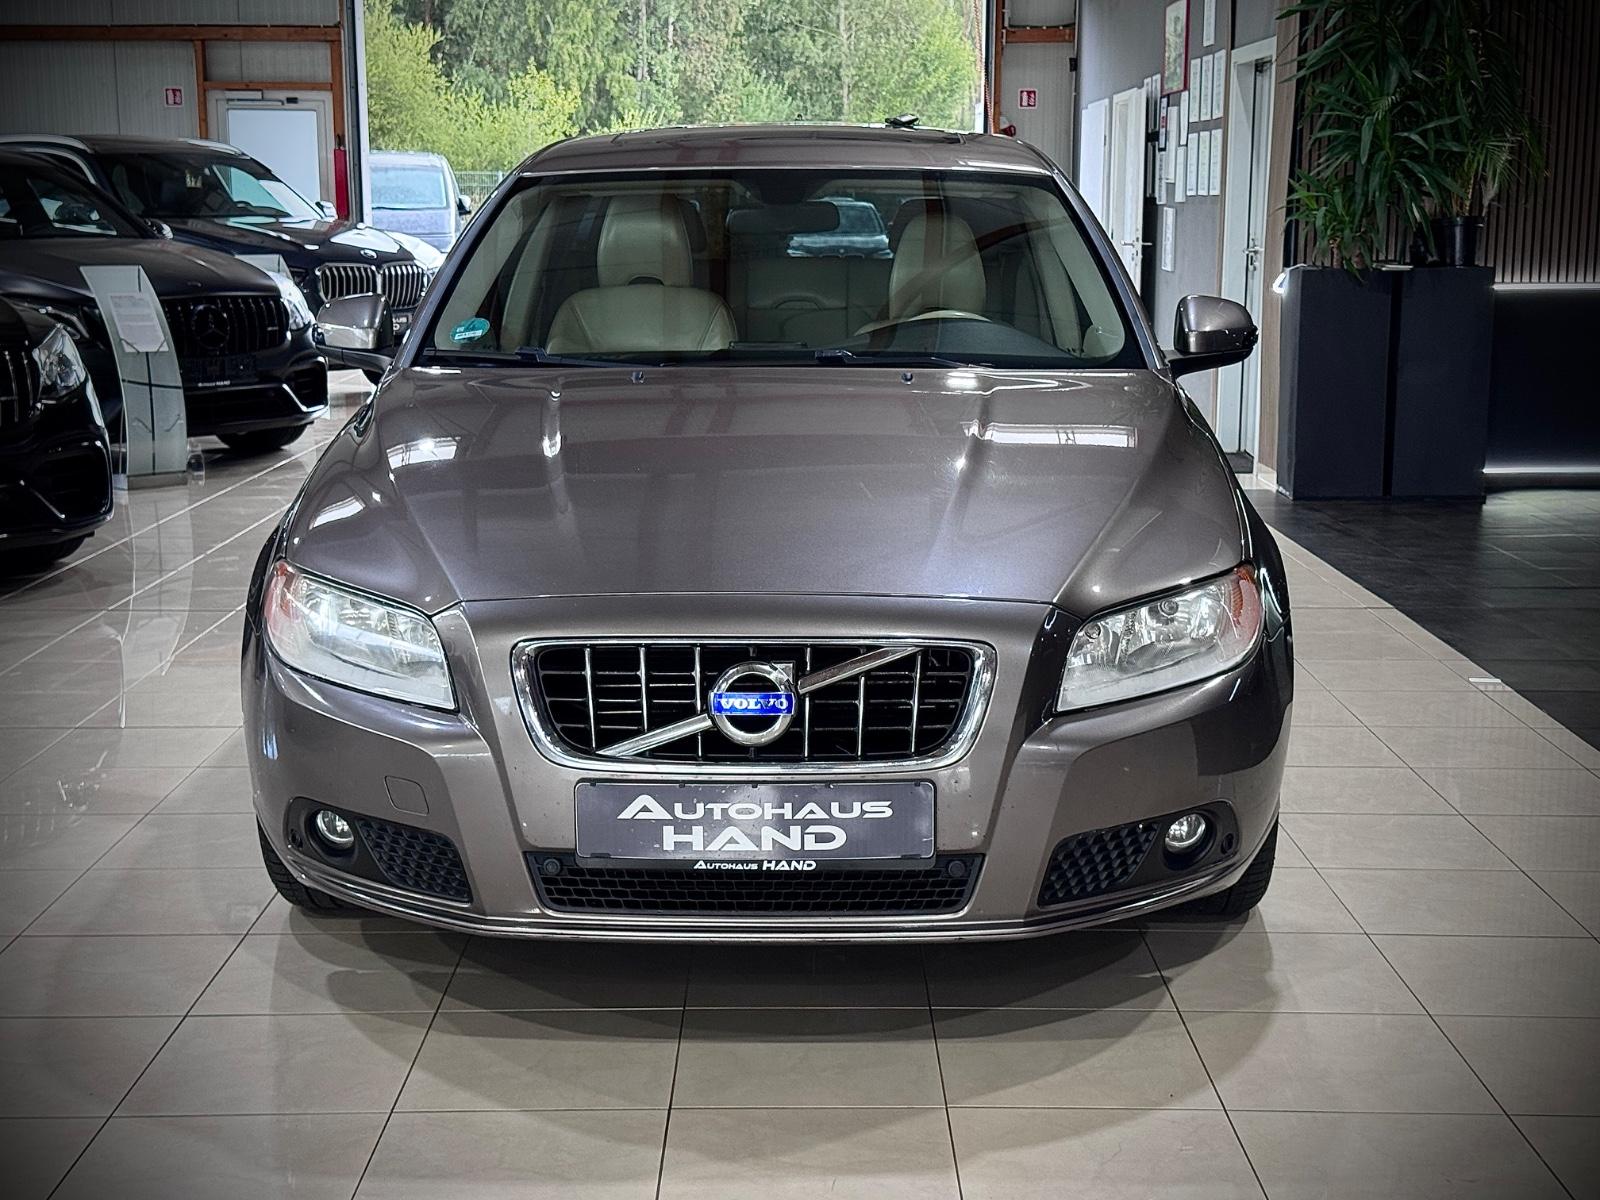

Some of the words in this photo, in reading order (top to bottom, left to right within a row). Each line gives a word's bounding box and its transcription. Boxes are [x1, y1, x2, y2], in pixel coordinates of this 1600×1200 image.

[717, 698, 789, 710] VOLVO
[617, 795, 893, 820] AUTOHAUS
[663, 825, 847, 851] HAND
[693, 860, 759, 870] AUTOHAUS
[762, 860, 817, 871] HAND
